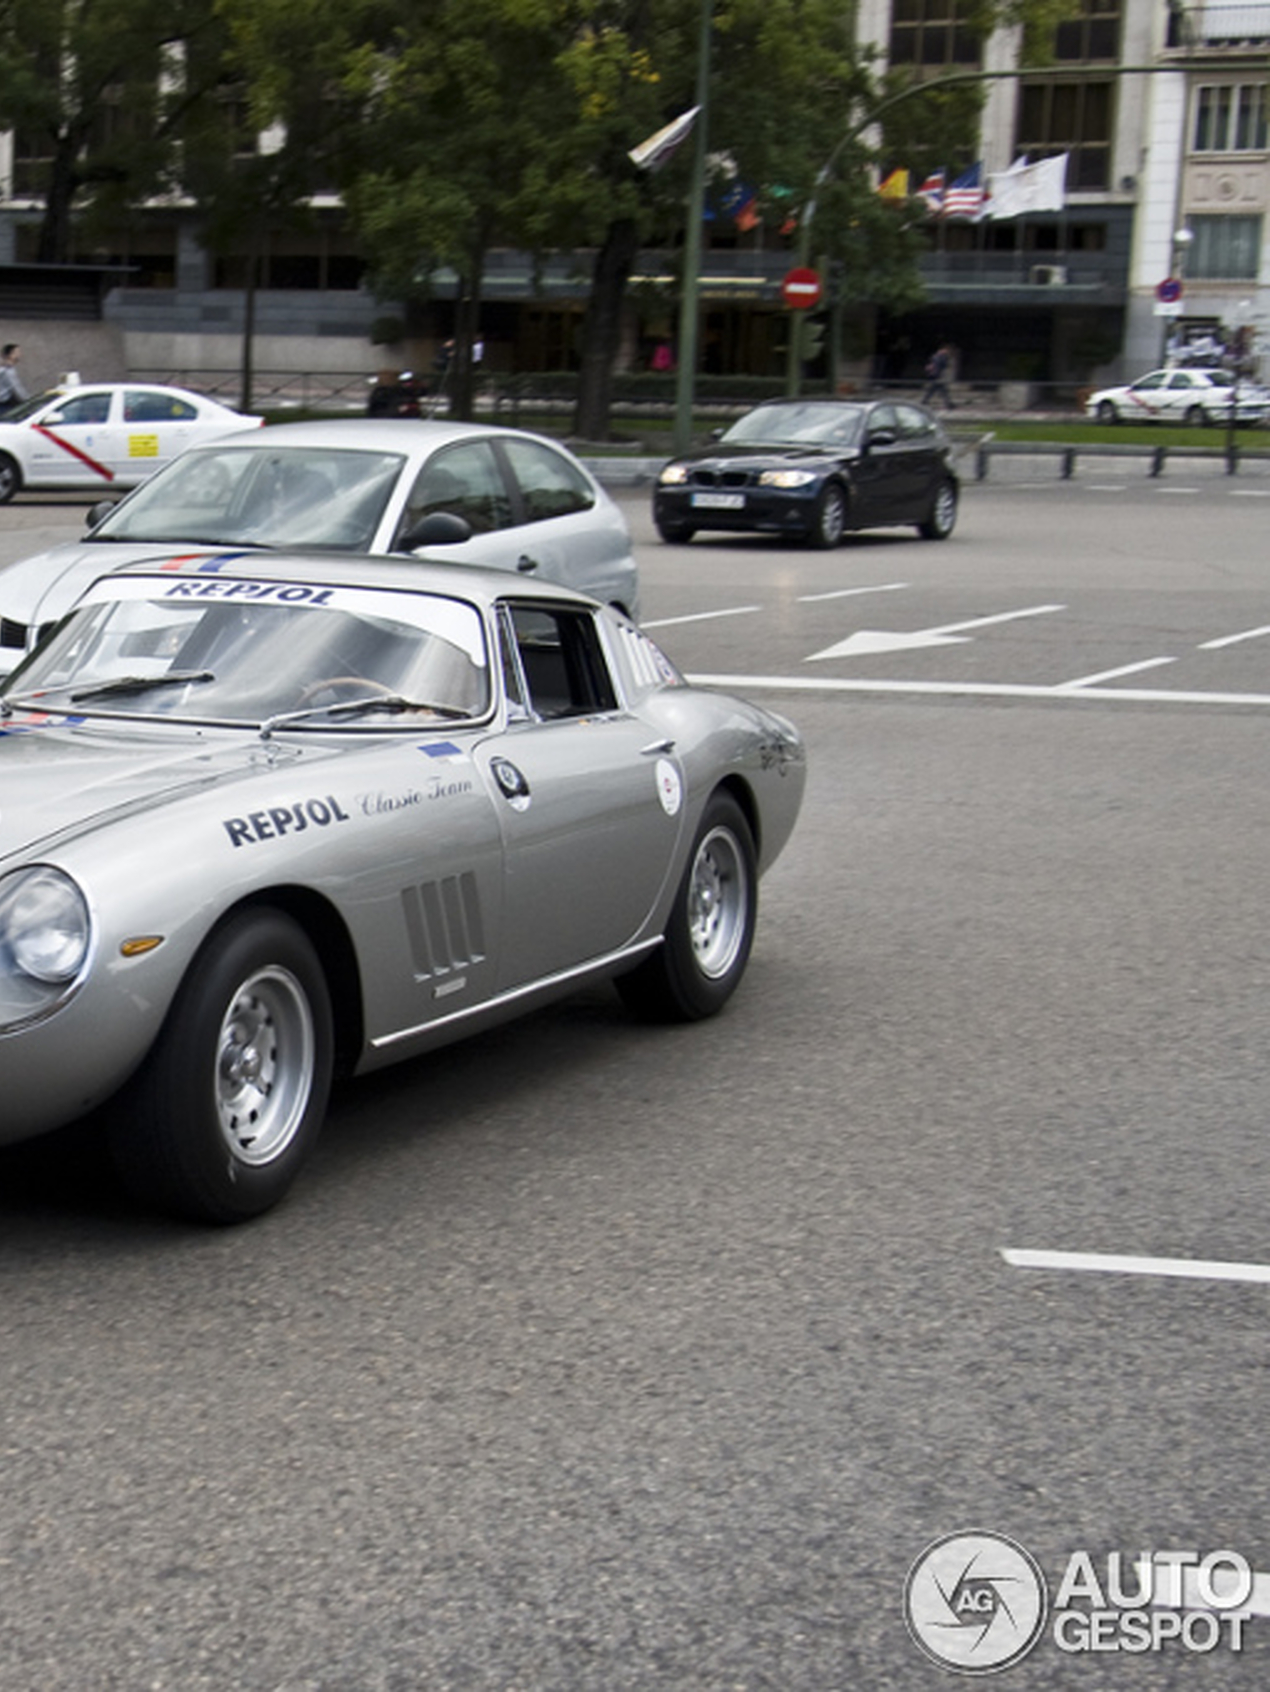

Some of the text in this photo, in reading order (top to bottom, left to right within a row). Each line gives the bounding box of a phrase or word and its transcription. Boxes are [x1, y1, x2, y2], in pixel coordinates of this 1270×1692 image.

[164, 582, 335, 606] REPSOL
[223, 776, 472, 848] REPSOL Classic Team
